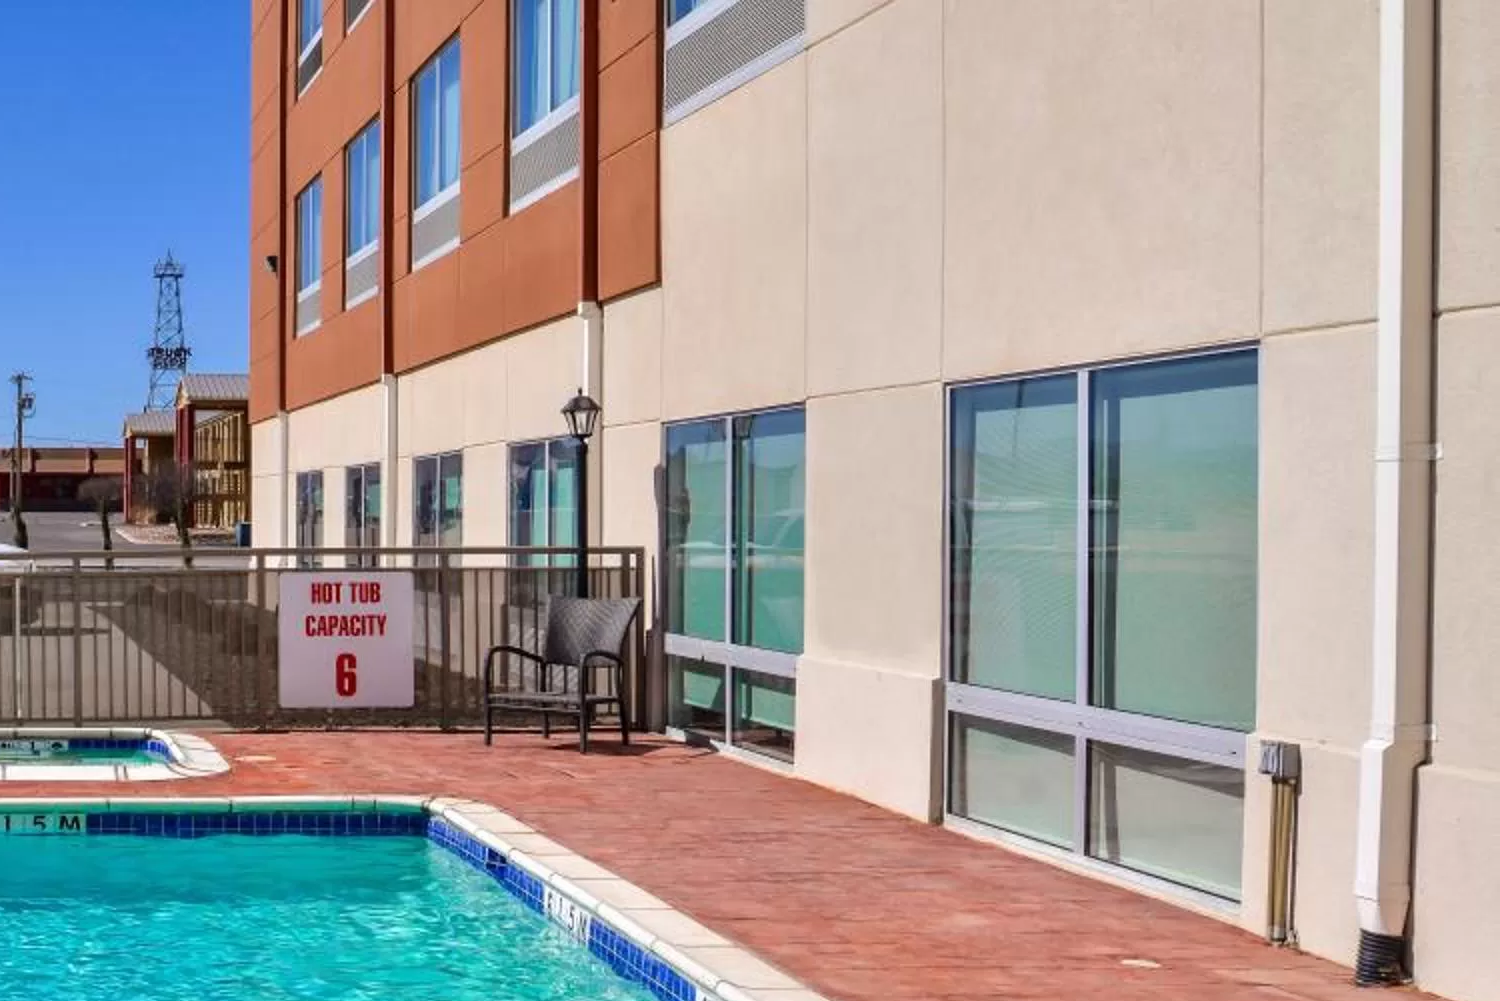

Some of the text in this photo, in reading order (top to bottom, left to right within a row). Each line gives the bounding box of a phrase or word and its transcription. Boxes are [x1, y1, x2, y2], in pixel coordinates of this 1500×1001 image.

[311, 581, 381, 605] HOT TUB
[305, 614, 387, 637] CAPACITY
[335, 653, 357, 697] 6
